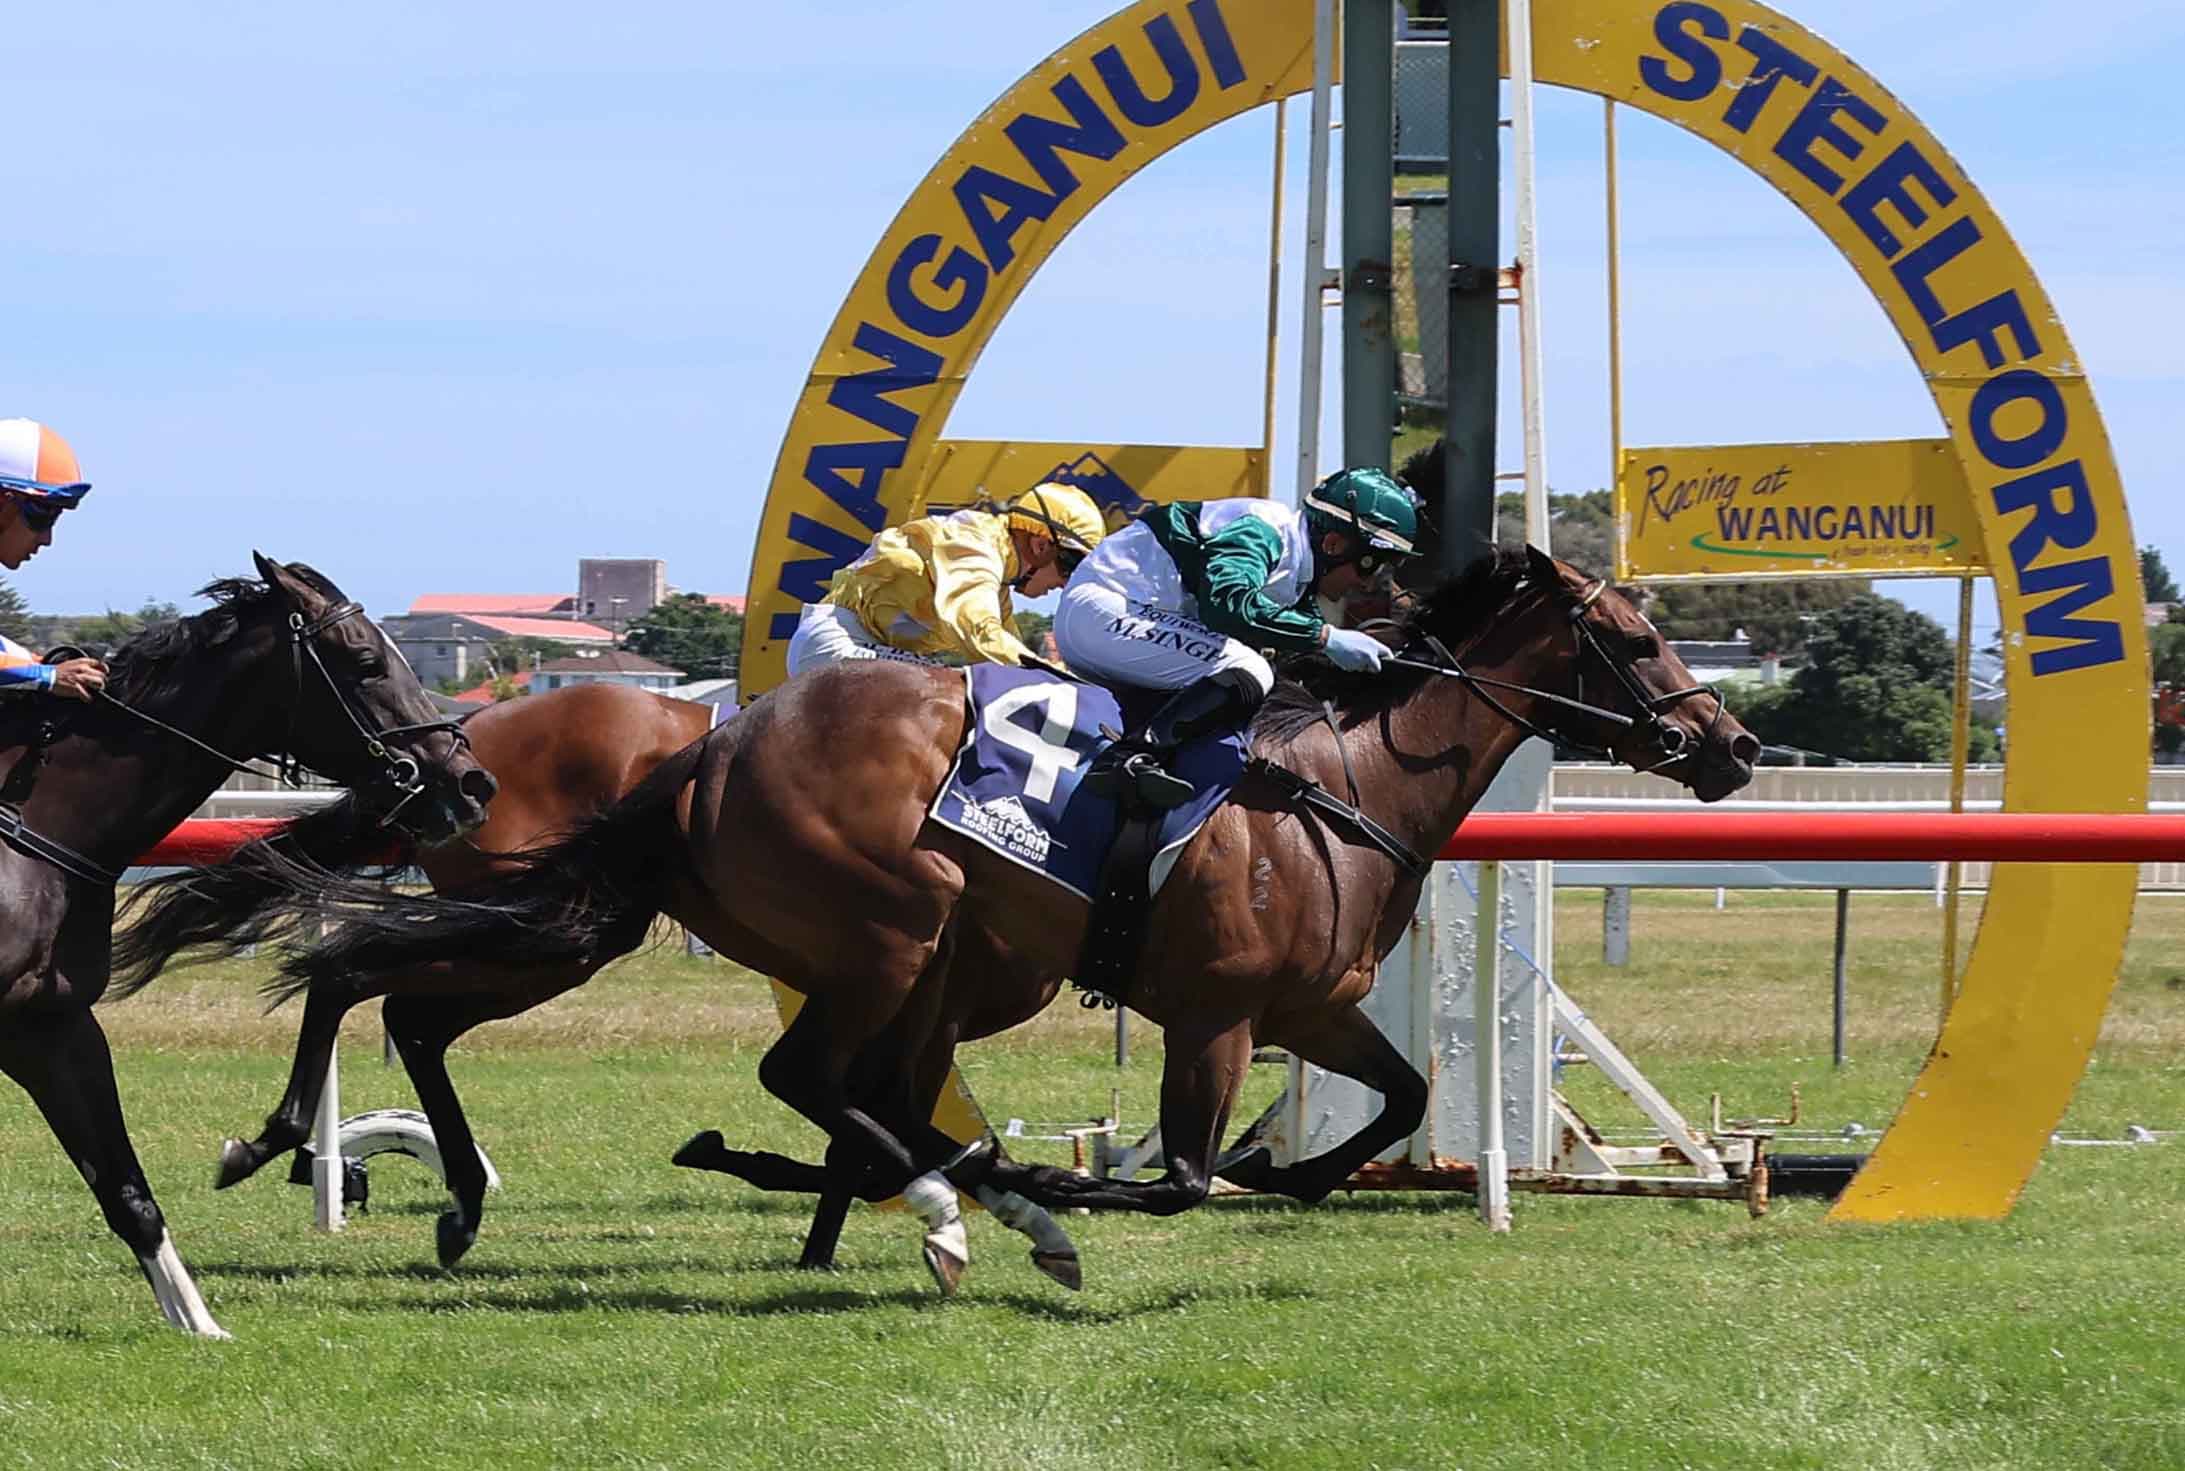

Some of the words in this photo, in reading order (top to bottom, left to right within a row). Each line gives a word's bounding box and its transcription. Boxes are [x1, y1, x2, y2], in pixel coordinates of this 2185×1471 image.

[1638, 0, 2124, 677] STEELFORM
[1637, 464, 1741, 539] Racing
[1752, 464, 1792, 496] at
[1717, 504, 1935, 541] WANGANUI
[984, 682, 1080, 804] 4
[960, 816, 1006, 845] ROOFING
[1008, 841, 1046, 862] GROUP
[962, 803, 1050, 855] STEELFORM
